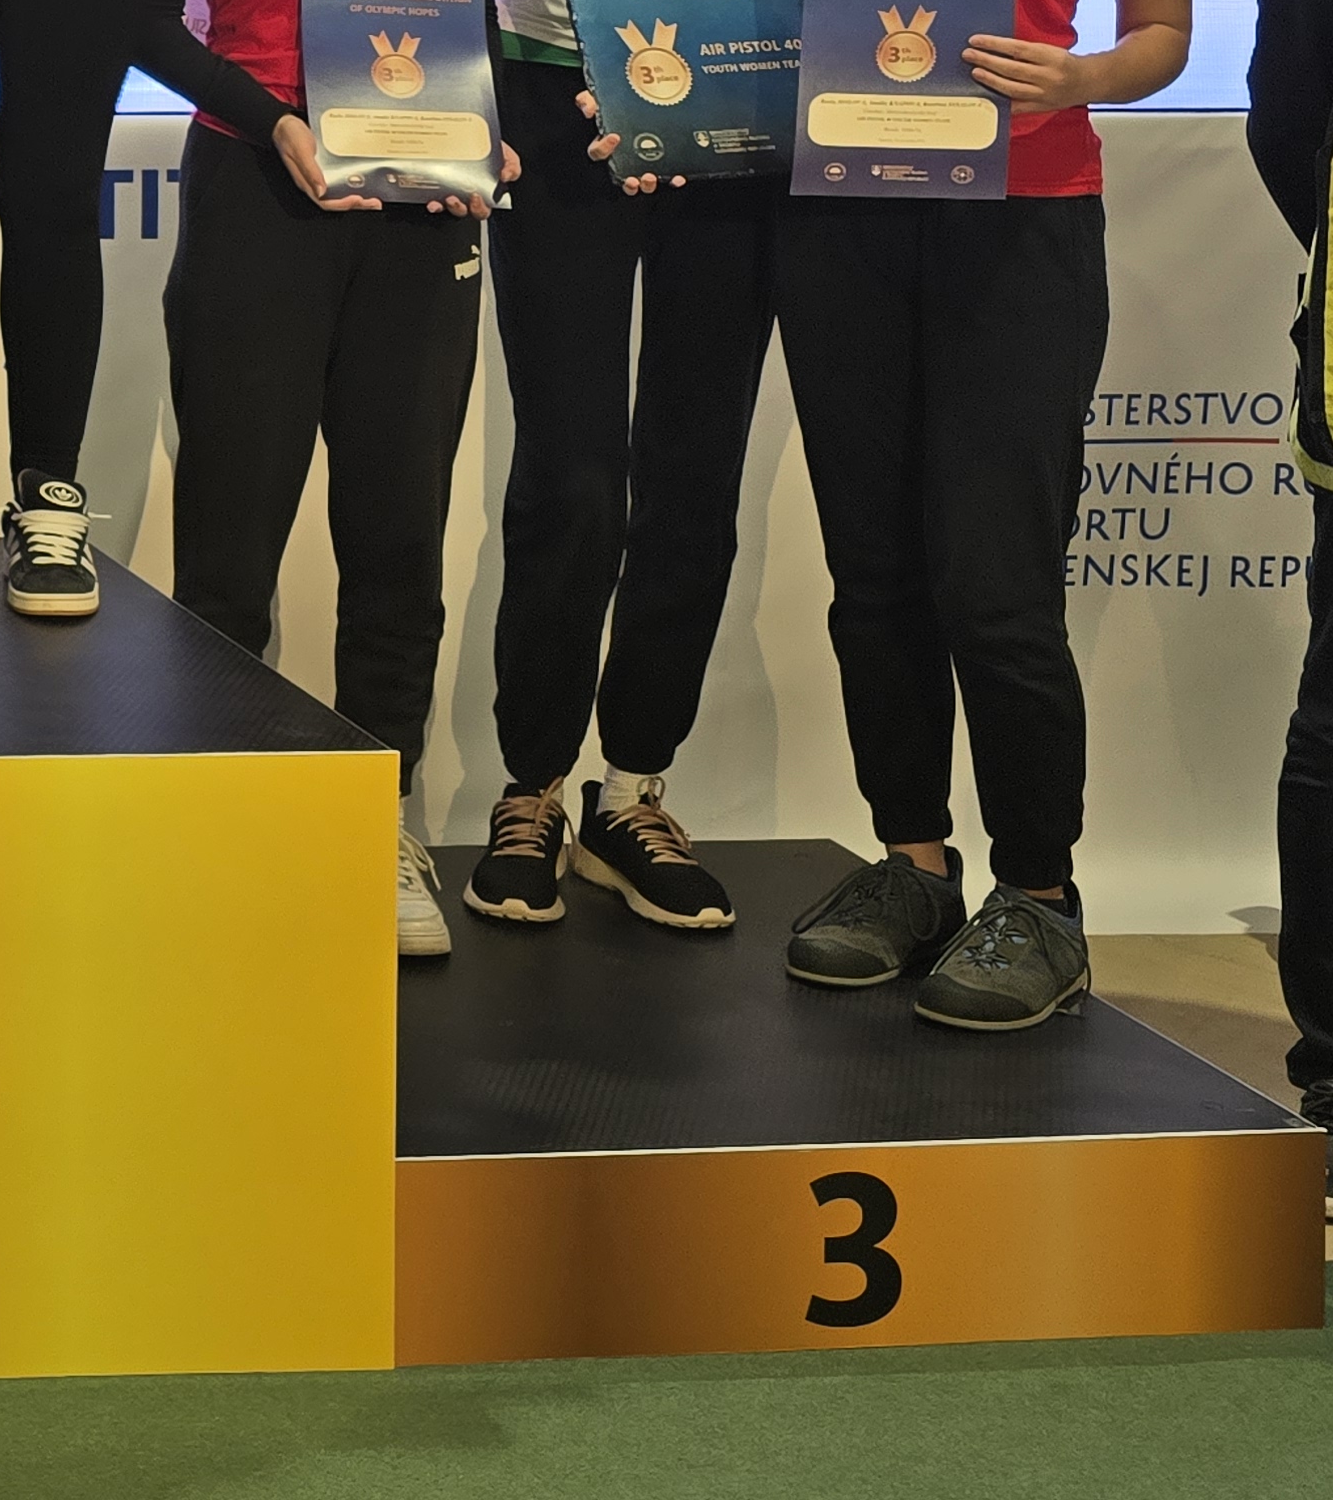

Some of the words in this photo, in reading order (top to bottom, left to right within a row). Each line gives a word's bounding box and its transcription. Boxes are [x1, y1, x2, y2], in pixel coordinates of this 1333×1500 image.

[350, 4, 362, 12] OF
[365, 5, 406, 15] OLYMPIC
[408, 7, 440, 17] HOPES
[700, 41, 726, 56] AIR
[729, 40, 781, 54] PISTOL
[784, 38, 802, 50] 40
[701, 63, 739, 74] YOUTH
[740, 61, 781, 72] WOMEN
[782, 59, 801, 69] TEA
[657, 74, 679, 84] place
[1084, 392, 1284, 427] STERSTVO
[1064, 553, 1210, 597] ENSKEJ
[806, 1172, 901, 1327] 3
